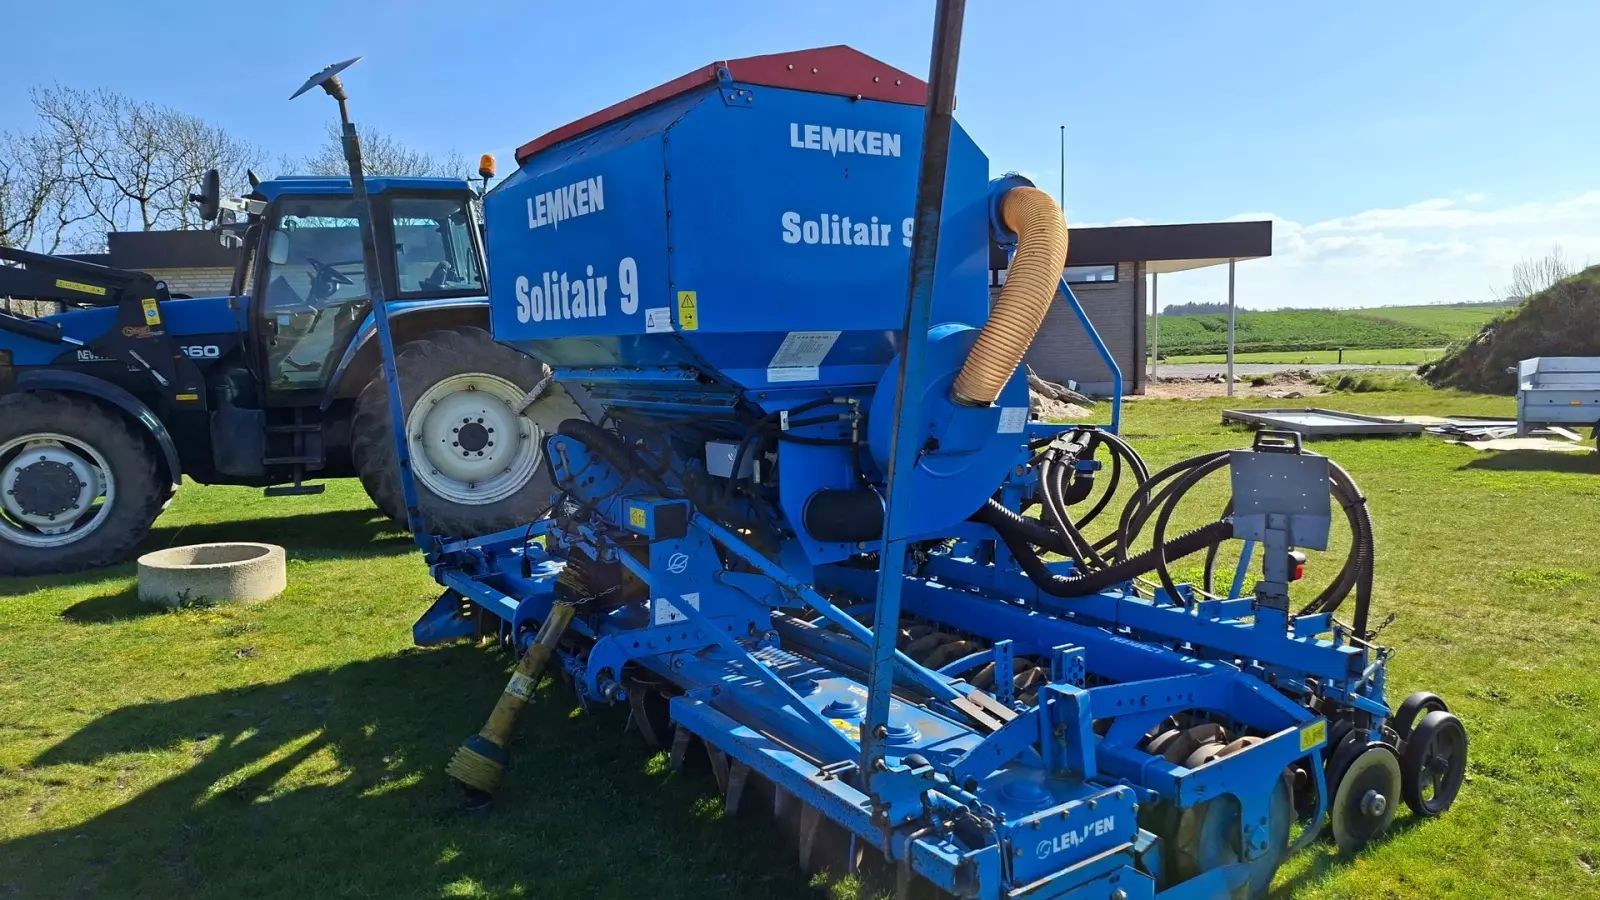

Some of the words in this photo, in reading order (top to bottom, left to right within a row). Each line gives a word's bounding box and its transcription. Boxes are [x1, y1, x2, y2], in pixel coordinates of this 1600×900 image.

[790, 123, 901, 158] LEMKEN
[527, 175, 605, 232] LEMKEN
[781, 211, 891, 247] Solitair
[902, 217, 914, 248] 9
[515, 264, 608, 324] Solitair
[618, 256, 639, 315] 9
